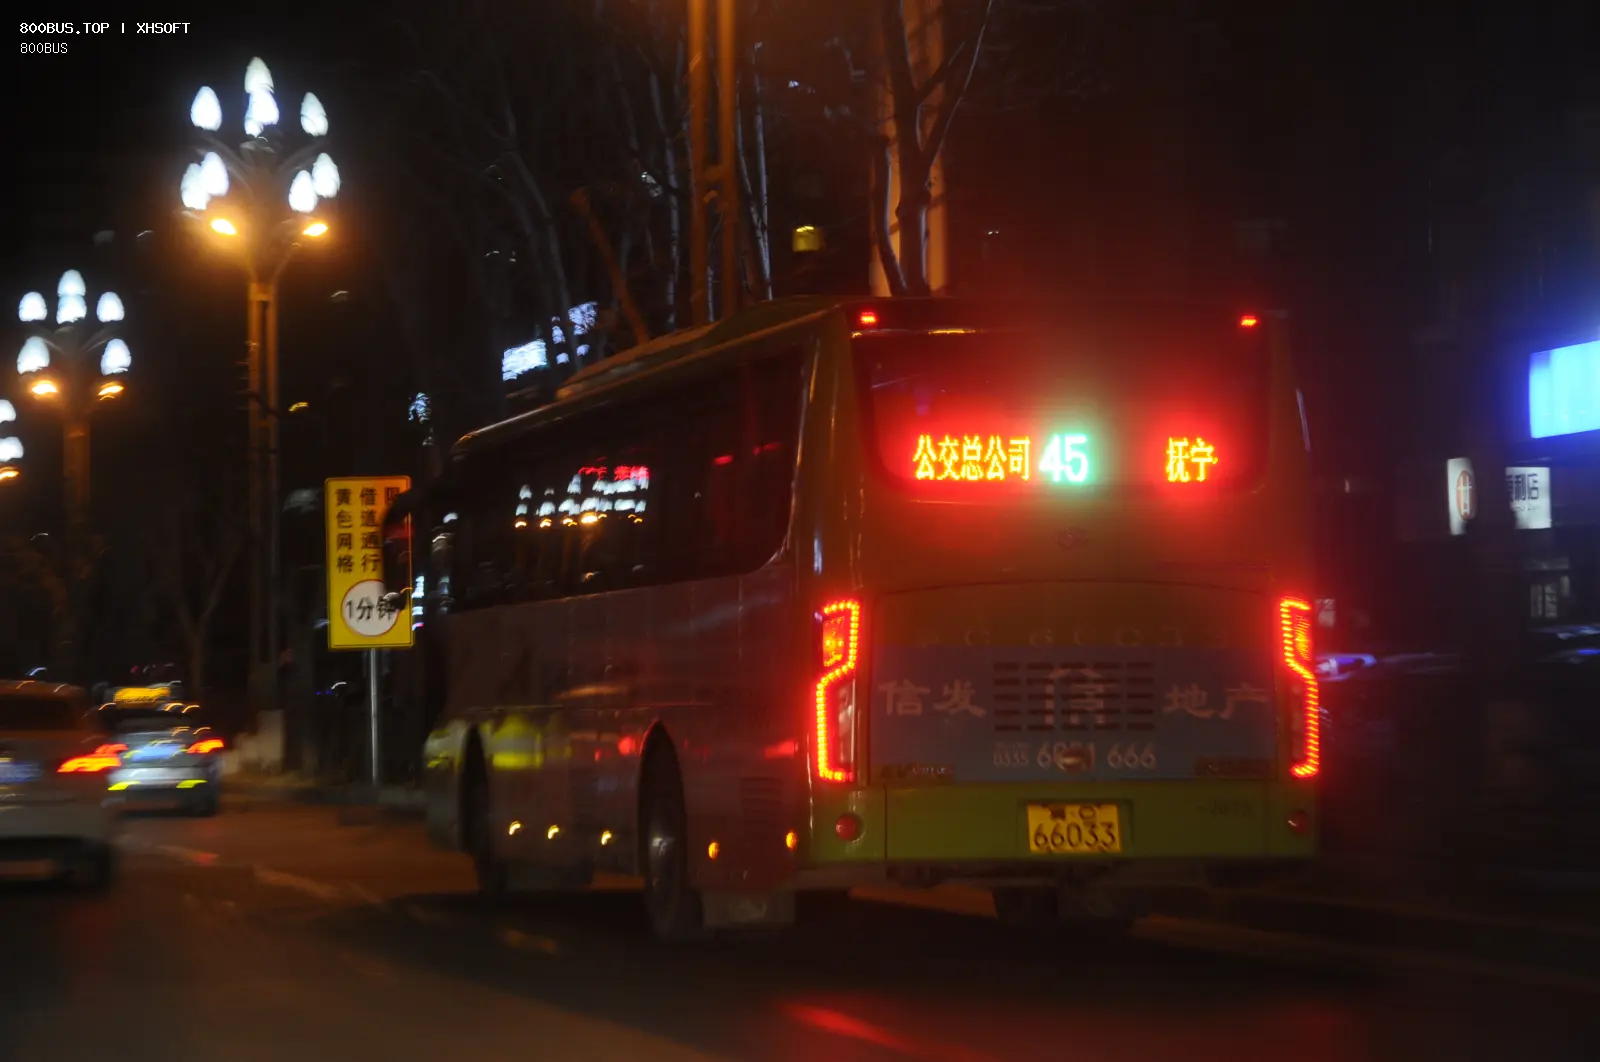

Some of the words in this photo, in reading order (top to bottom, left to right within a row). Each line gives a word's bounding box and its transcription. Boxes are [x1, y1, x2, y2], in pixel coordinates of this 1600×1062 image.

[912, 434, 1031, 482] 公交总公司
[1038, 433, 1090, 483] 45
[335, 487, 354, 574] 黄色网格
[360, 486, 381, 574] 借道通行
[877, 678, 988, 718] 信发
[1161, 681, 1268, 720] 地产
[1107, 742, 1157, 770] 666
[1033, 821, 1117, 849] 66033
